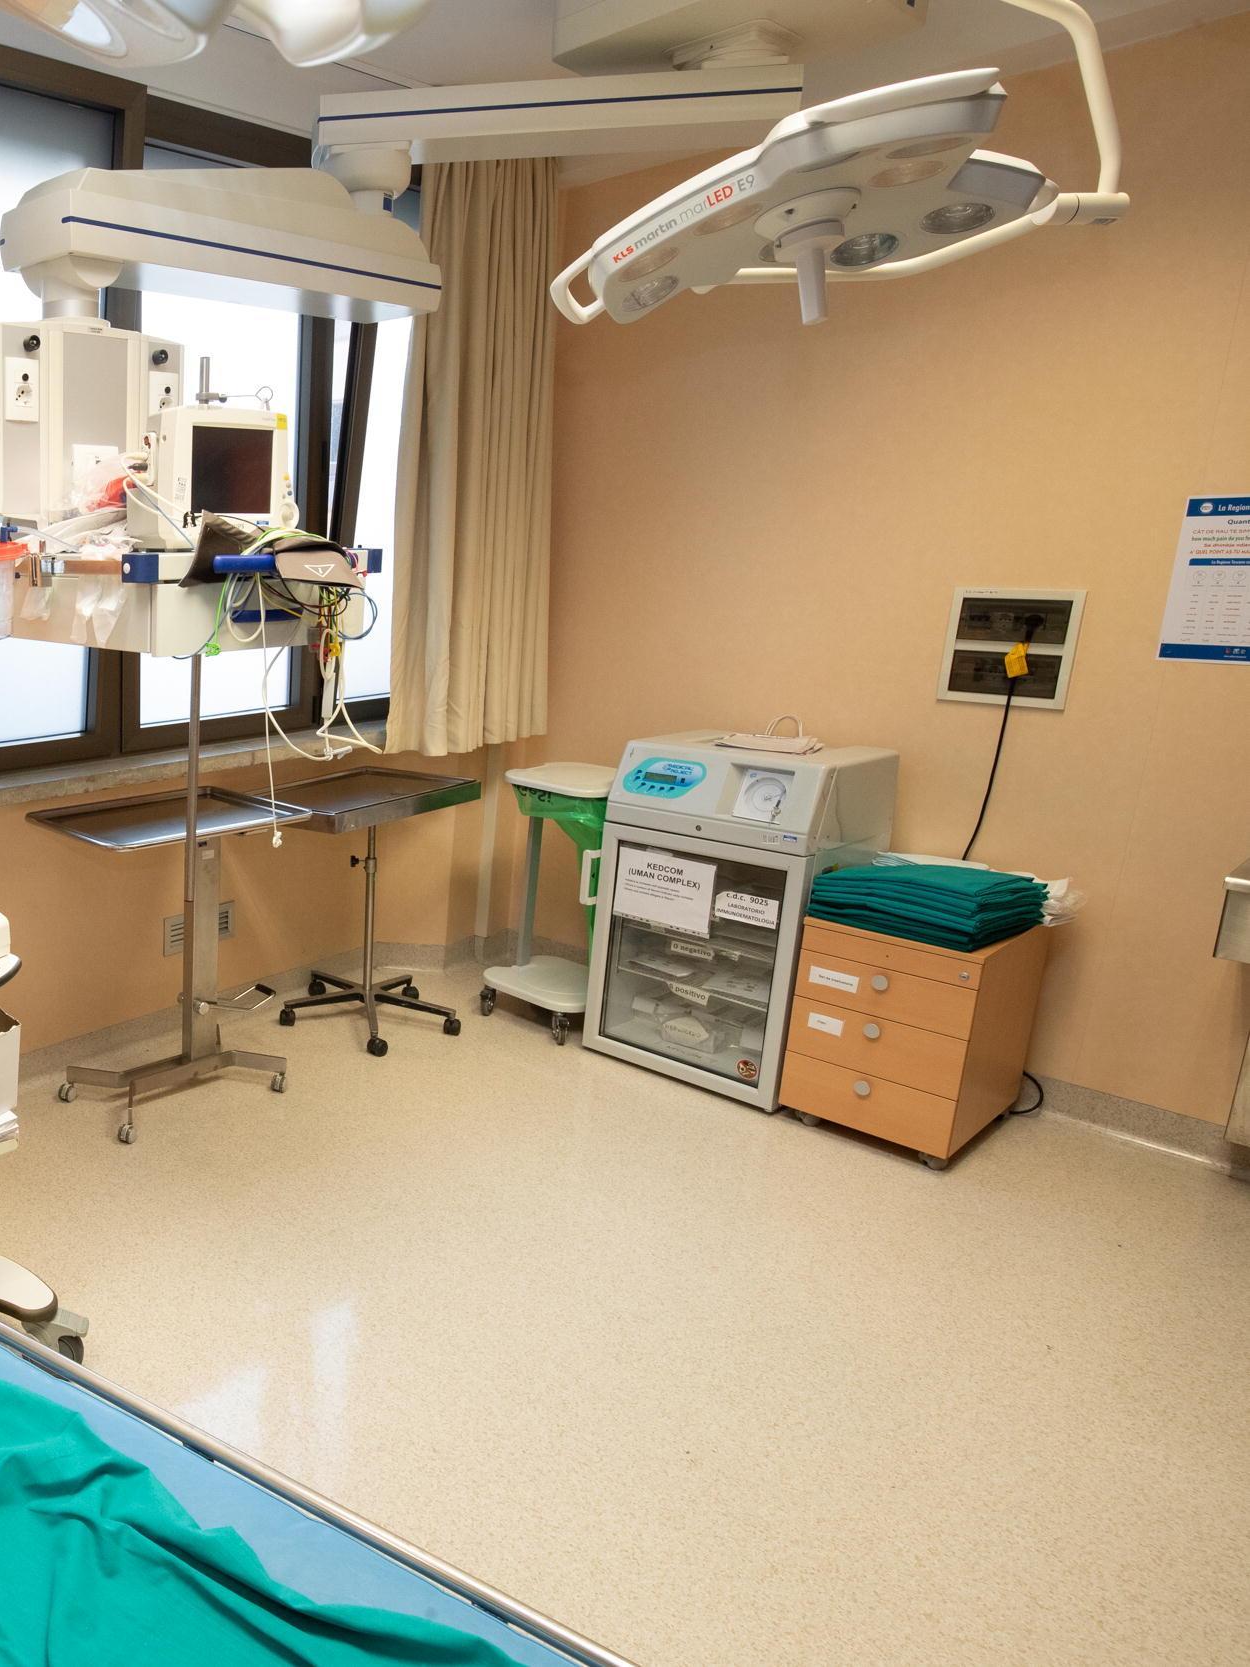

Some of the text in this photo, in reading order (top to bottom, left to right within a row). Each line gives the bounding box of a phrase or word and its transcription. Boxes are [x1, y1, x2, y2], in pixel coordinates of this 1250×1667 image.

[613, 174, 755, 263] KLS martin marLED E9
[647, 862, 684, 876] KEDCOM
[628, 867, 655, 880] (UMAN
[656, 873, 701, 890] COMPLEX)
[749, 896, 769, 906] 9025
[727, 902, 765, 915] LABORATORIO
[680, 945, 711, 957] negativo
[675, 986, 706, 1000] positivo
